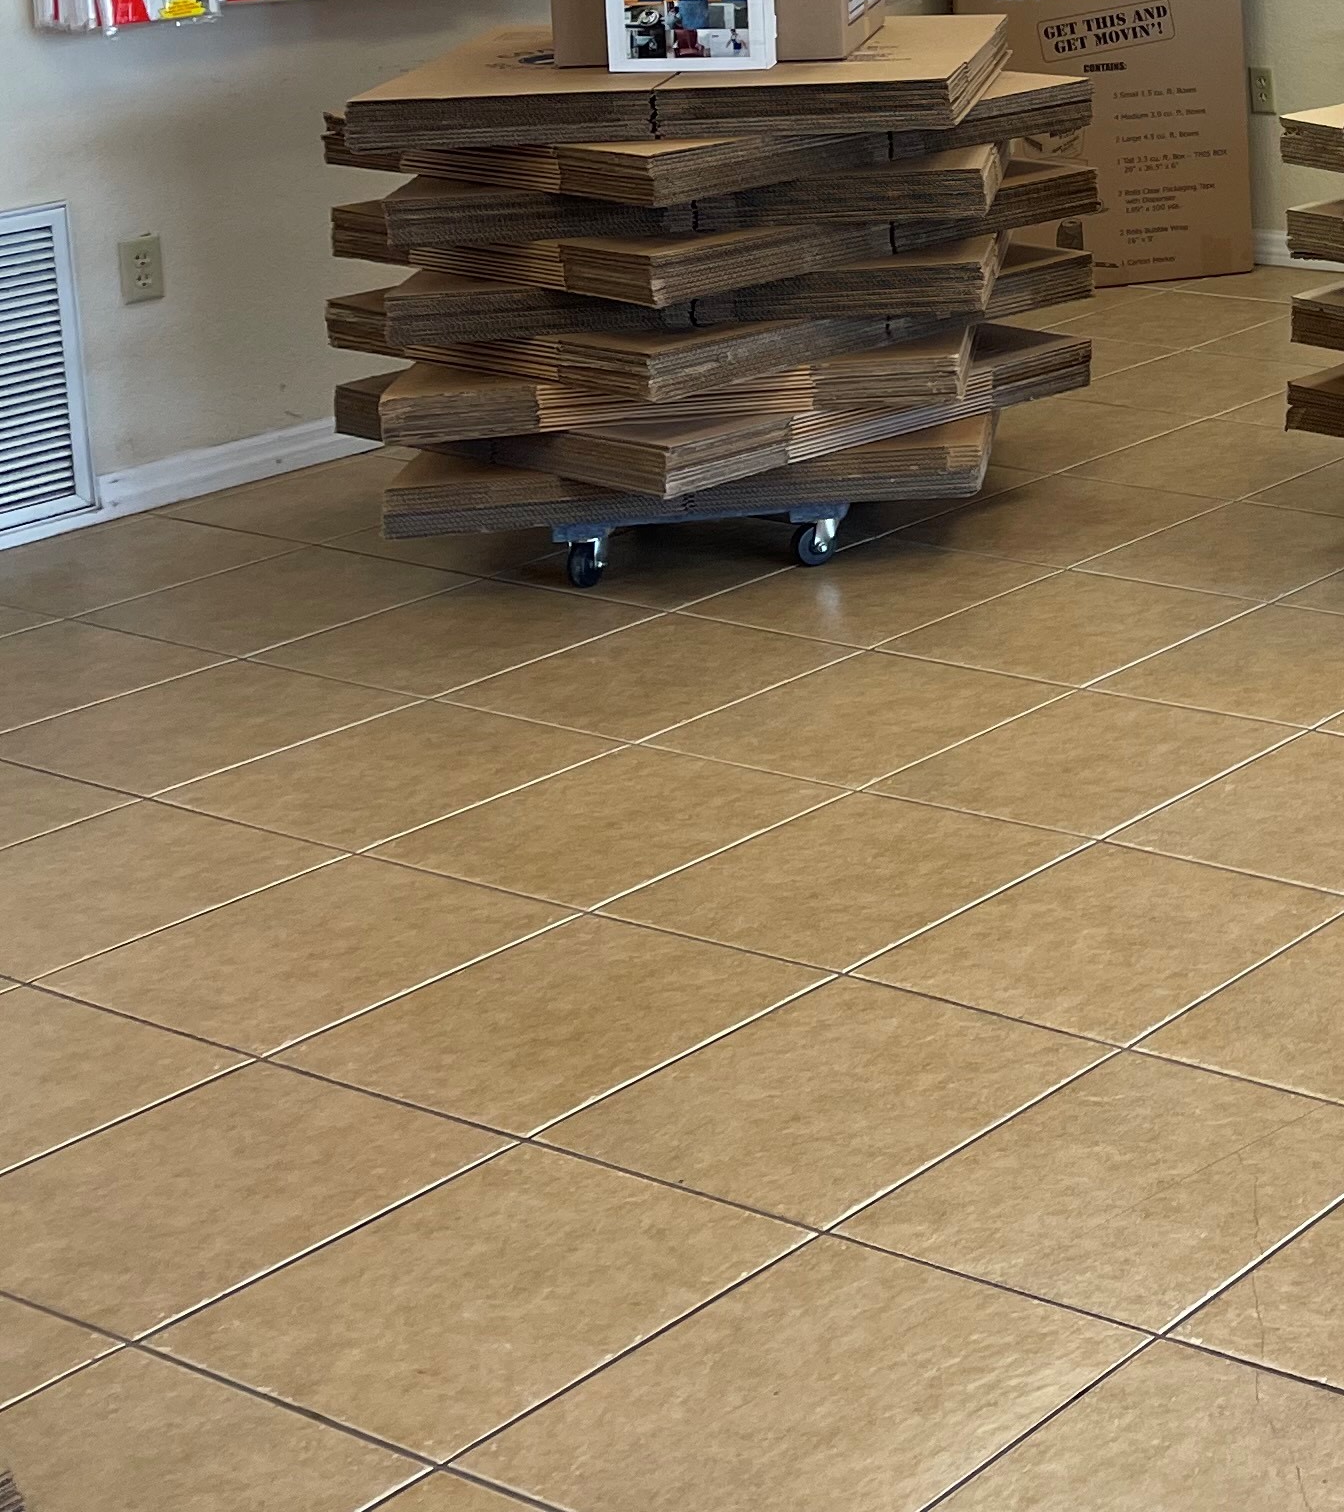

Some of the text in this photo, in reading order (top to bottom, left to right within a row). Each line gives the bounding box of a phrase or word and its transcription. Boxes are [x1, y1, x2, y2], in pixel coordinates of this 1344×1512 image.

[1043, 4, 1169, 41] GET THIS AND
[1054, 35, 1088, 54] GET
[1083, 61, 1127, 73] CONTAINS:
